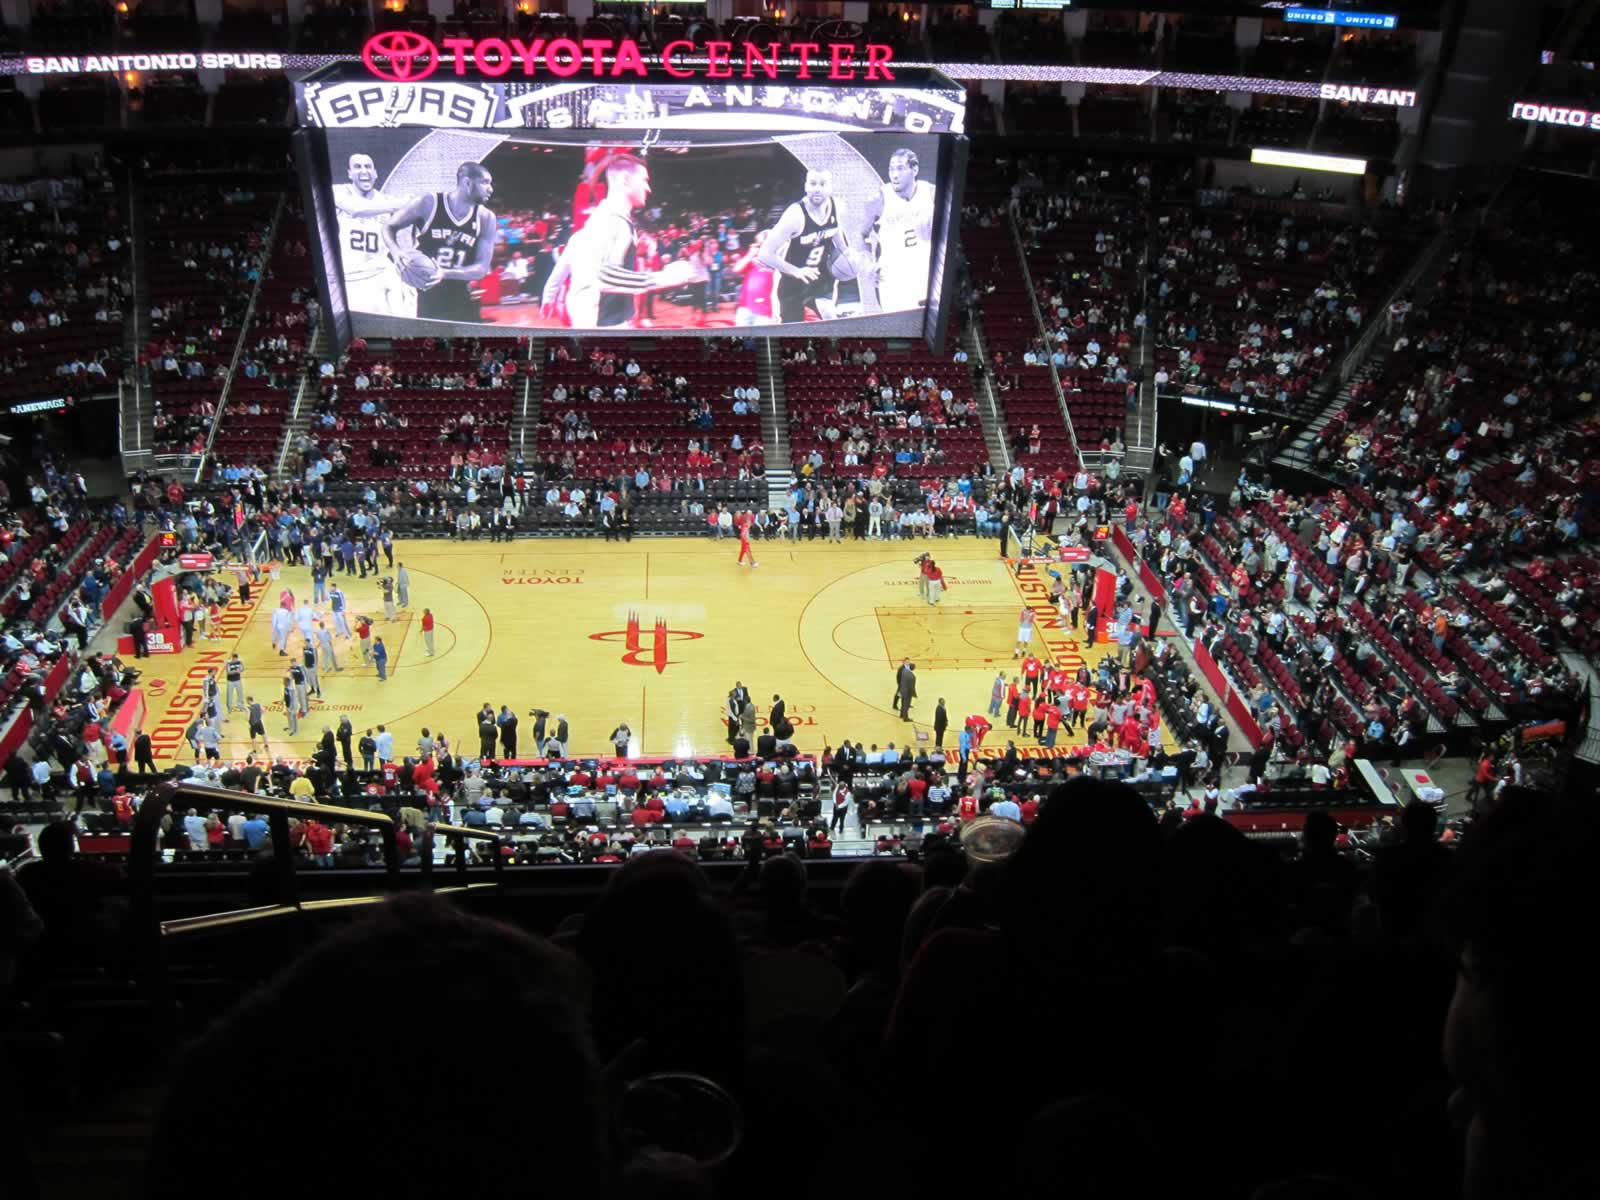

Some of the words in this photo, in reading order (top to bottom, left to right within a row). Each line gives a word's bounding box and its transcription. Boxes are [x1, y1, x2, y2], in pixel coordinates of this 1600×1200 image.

[1287, 12, 1323, 20] UNITED
[1345, 16, 1383, 25] UNITED
[27, 57, 80, 73] SAN
[85, 54, 197, 72] ANTONIO
[202, 53, 282, 69] SPURS
[443, 37, 648, 77] TOYOTA
[661, 40, 896, 80] CENTER
[1320, 84, 1369, 102] SAN
[329, 86, 476, 125] SPURS
[350, 229, 379, 253] 20
[904, 229, 918, 248] 2
[437, 247, 467, 269] 21
[805, 245, 825, 267] 9
[502, 576, 585, 584] TOYOTA
[151, 651, 228, 760] HOUSTON
